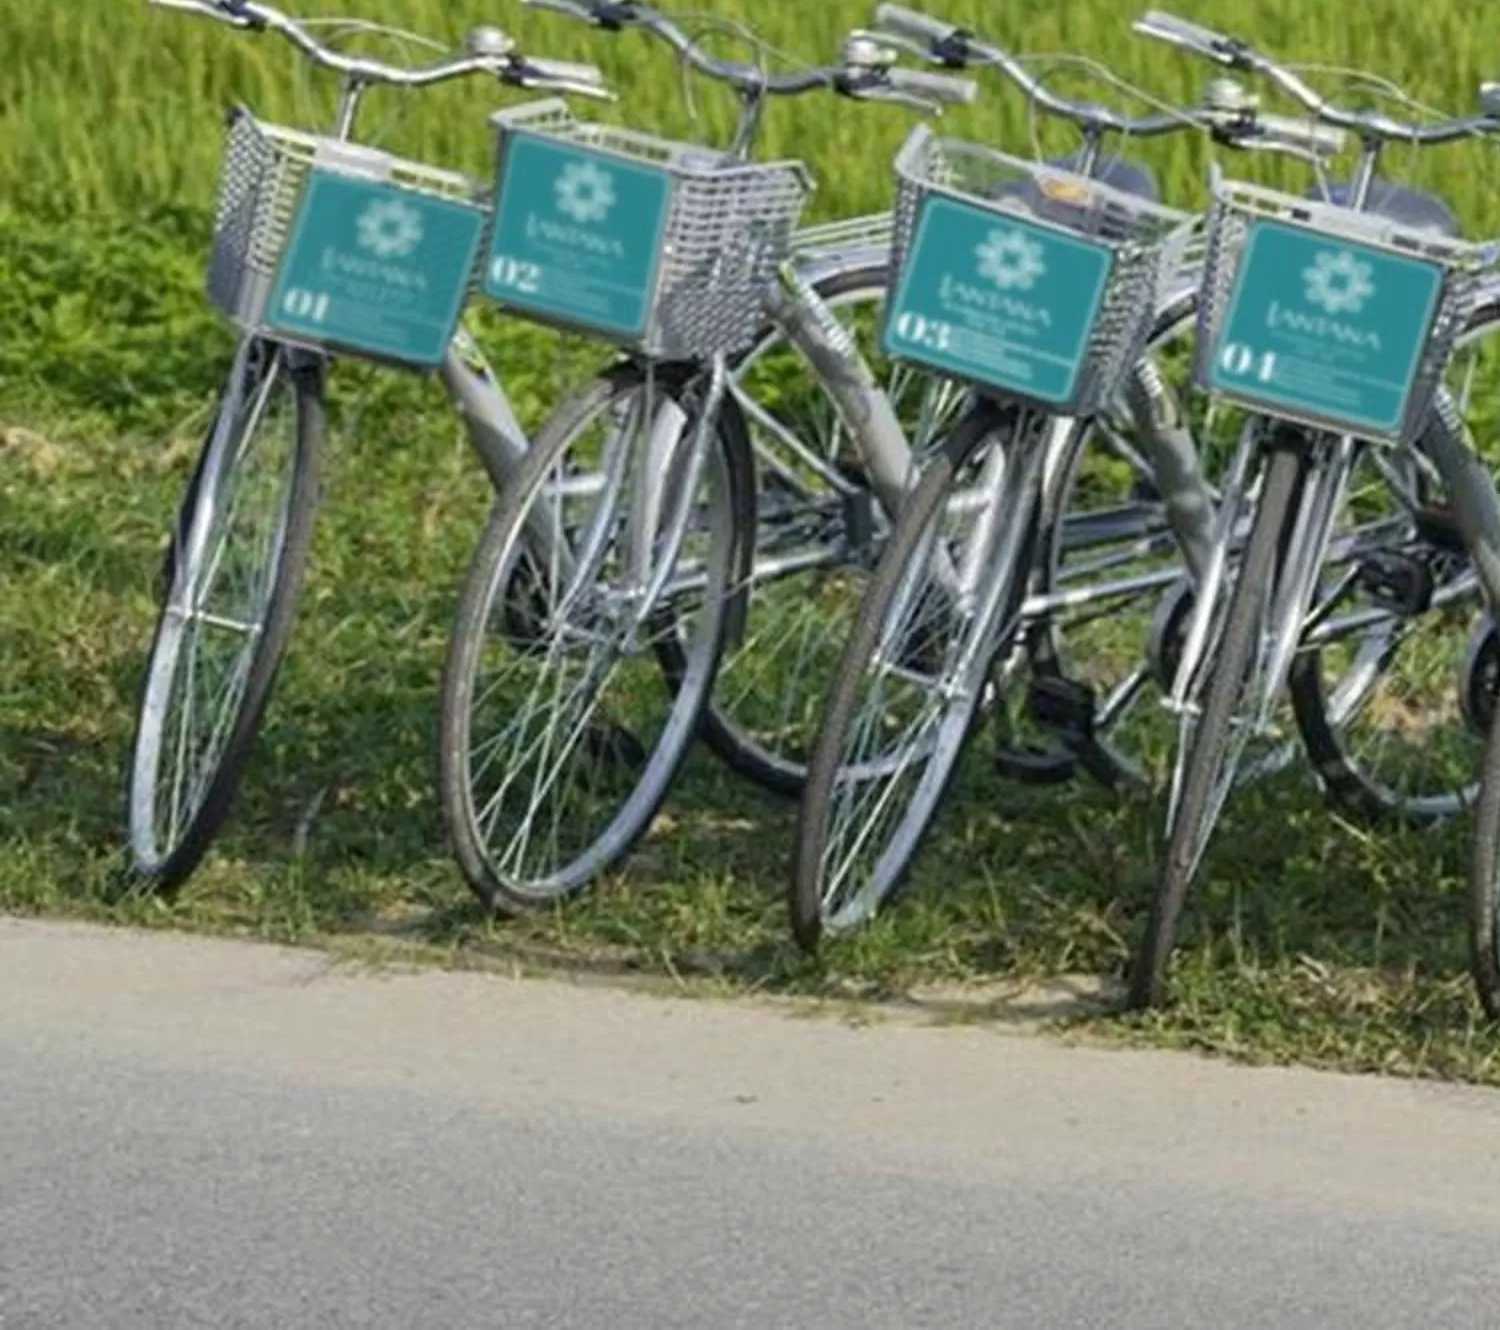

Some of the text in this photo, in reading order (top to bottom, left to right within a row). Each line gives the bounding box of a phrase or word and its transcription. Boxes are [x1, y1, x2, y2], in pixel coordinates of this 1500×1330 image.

[492, 255, 541, 293] 02
[939, 273, 1051, 327] LANTANA
[897, 310, 950, 350] 03
[1266, 299, 1381, 350] LANTANA
